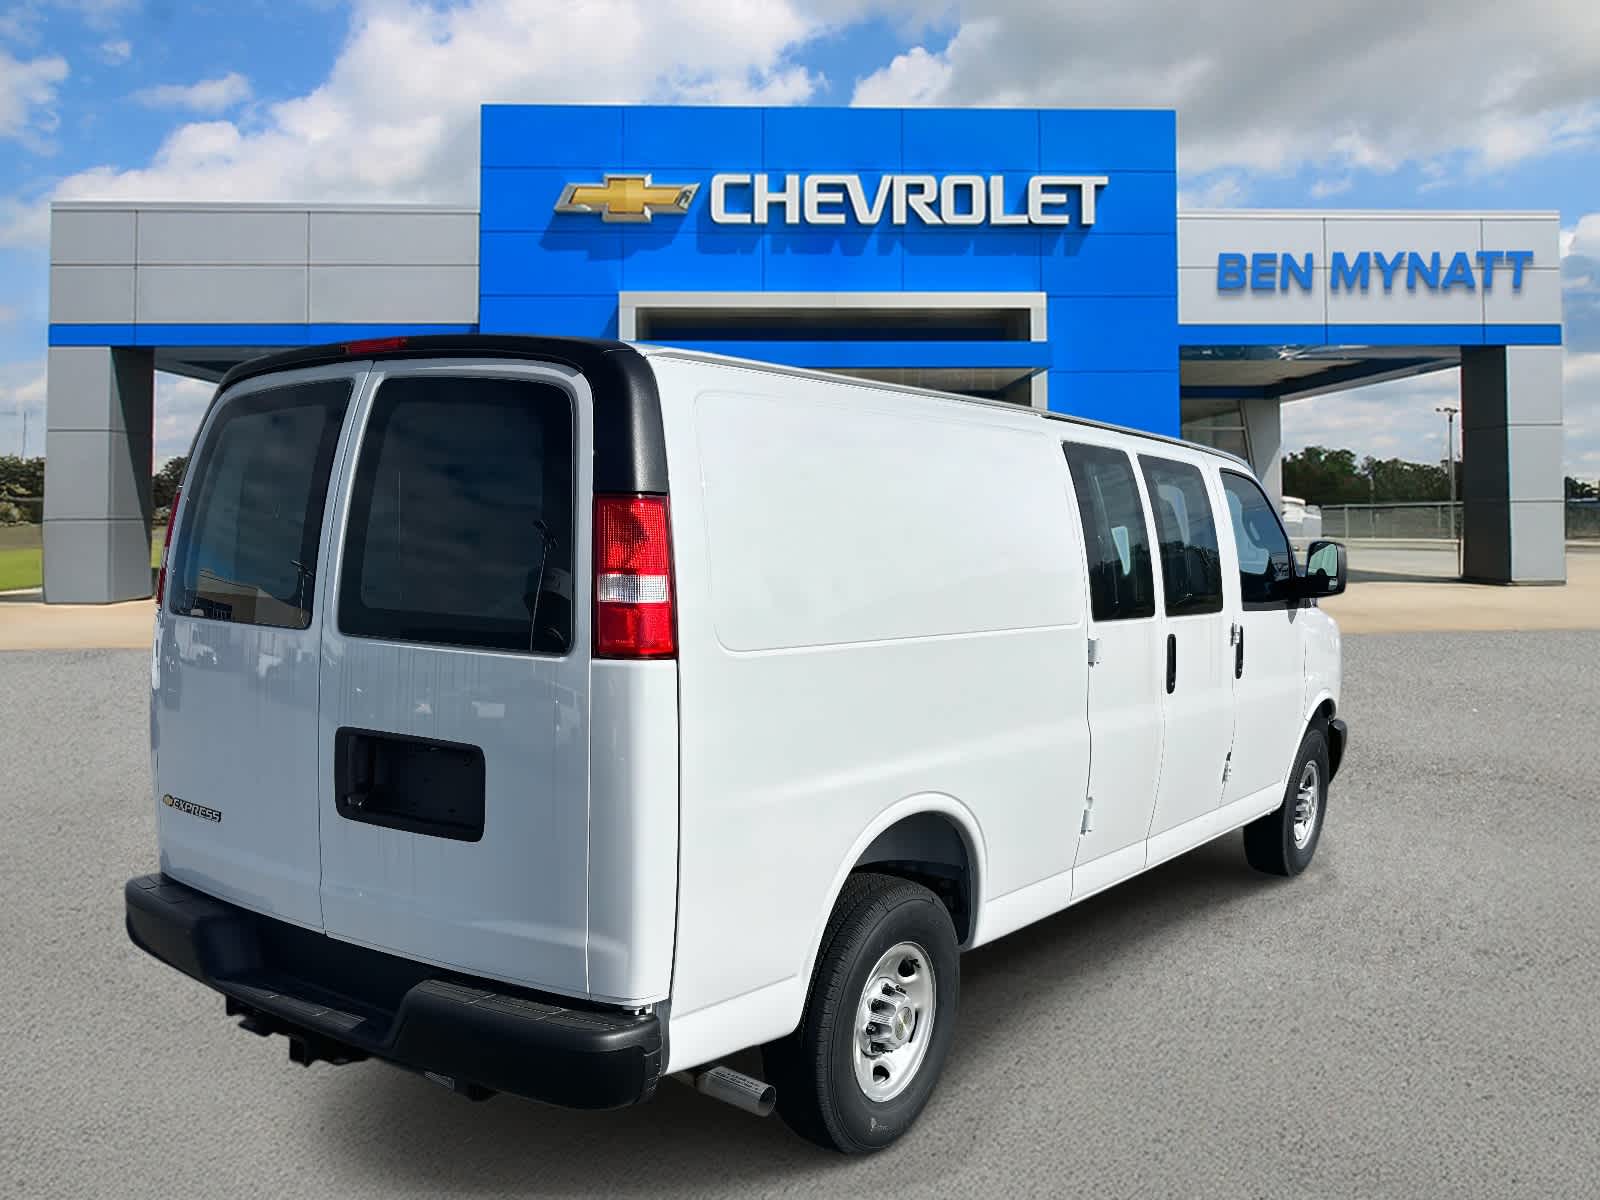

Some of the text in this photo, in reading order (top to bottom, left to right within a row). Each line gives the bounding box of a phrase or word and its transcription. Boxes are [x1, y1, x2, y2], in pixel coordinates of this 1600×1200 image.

[710, 173, 1110, 226] CHEVROLET
[1217, 250, 1534, 291] BEN MYNATT
[173, 797, 221, 822] EXPRESS
